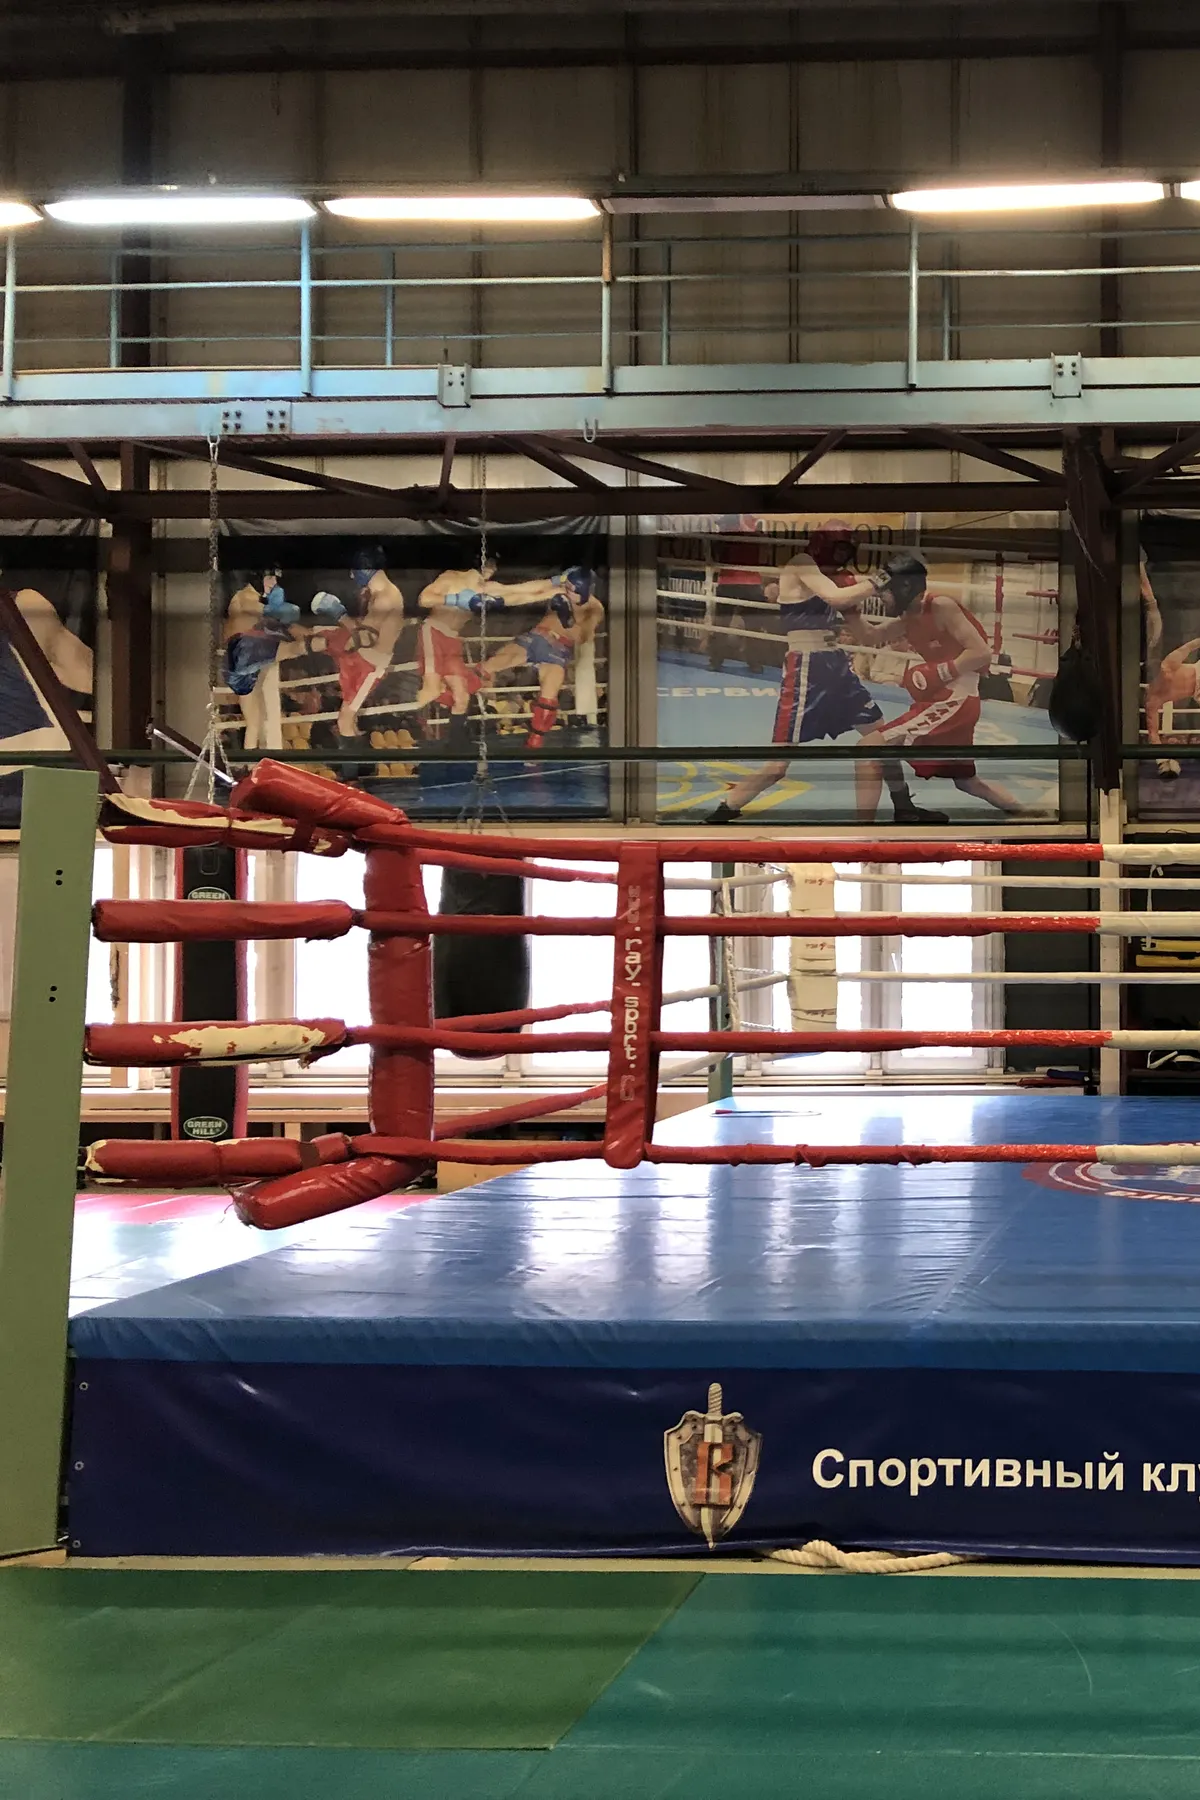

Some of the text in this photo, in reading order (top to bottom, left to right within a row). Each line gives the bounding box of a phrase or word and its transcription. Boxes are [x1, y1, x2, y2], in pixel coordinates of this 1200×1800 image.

[191, 891, 226, 900] GREEN
[186, 1120, 222, 1129] GREEN
[811, 1448, 1126, 1497] Спортивный
